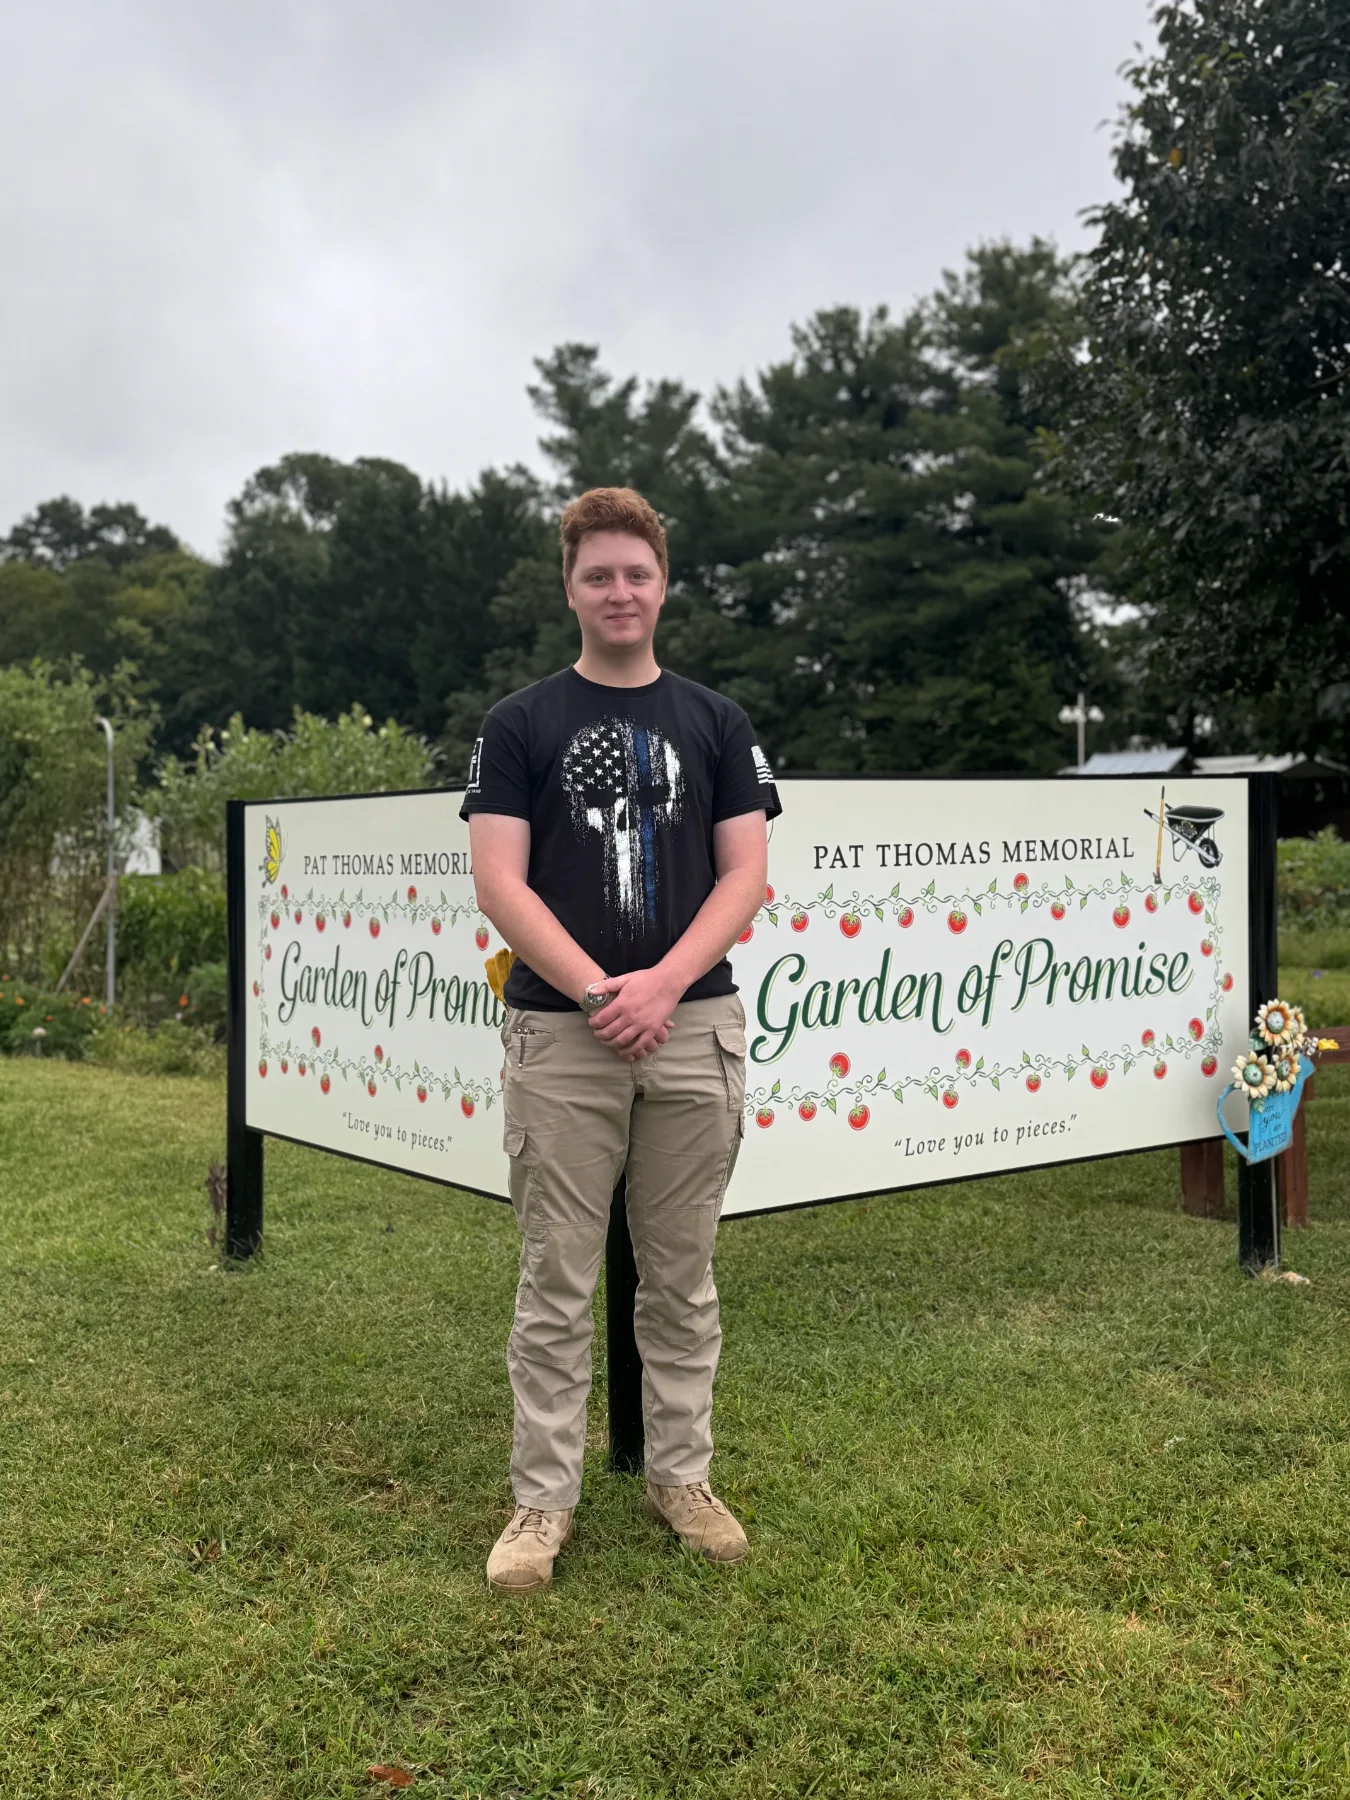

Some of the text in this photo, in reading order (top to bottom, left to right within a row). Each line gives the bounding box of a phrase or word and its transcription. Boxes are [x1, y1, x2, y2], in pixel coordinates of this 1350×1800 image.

[303, 852, 474, 876] PAT THOMAS MEMORI
[813, 836, 1135, 870] PAT THOMAS MEMORIAL
[278, 940, 506, 1031] Garden of Promi
[750, 936, 1195, 1065] Garden of Promise
[373, 1121, 392, 1141] you
[397, 1126, 407, 1143] to
[953, 1131, 985, 1155] you
[993, 1126, 1009, 1143] to
[1254, 1131, 1287, 1153] PLANTED
